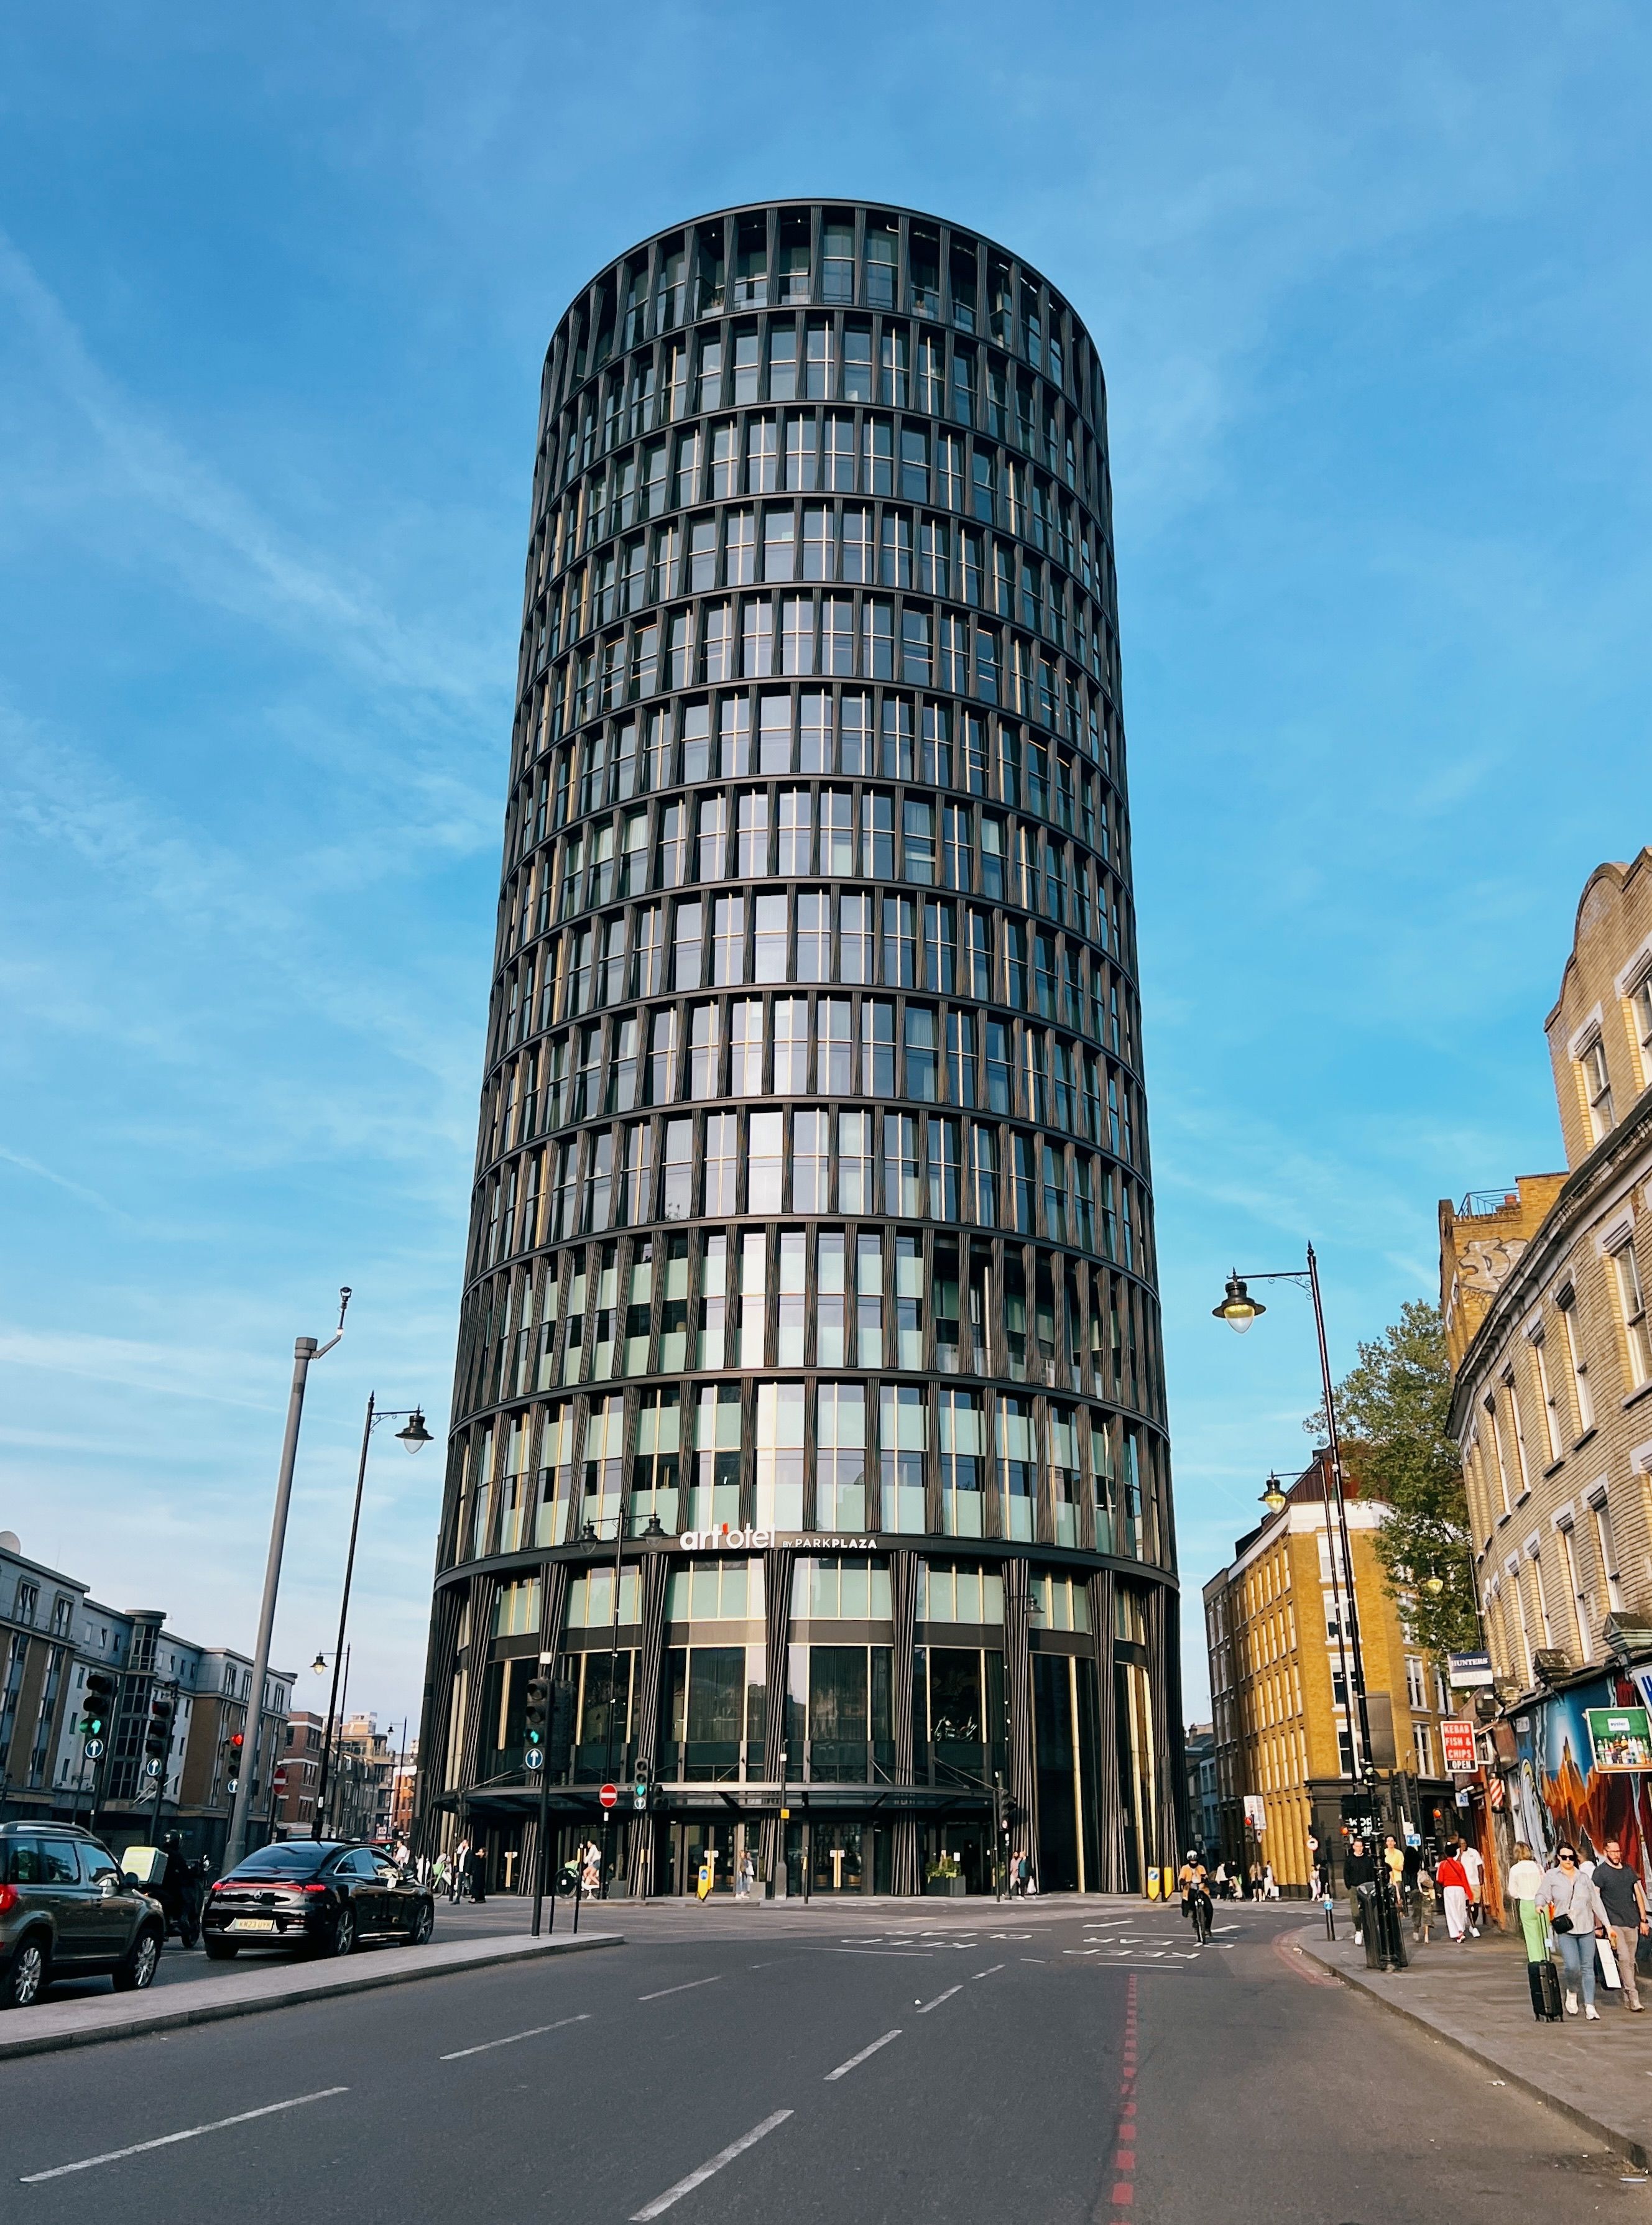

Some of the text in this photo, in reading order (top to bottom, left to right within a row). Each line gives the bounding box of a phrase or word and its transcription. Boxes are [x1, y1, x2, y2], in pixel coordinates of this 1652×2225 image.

[680, 1522, 775, 1550] art'otel
[1451, 1657, 1488, 1667] HUNTERS
[1444, 1725, 1470, 1734] KEBAB
[1445, 1737, 1472, 1746] FISH &
[1447, 1749, 1472, 1759] CHIPS
[1452, 1760, 1472, 1769] OPEN
[841, 1938, 979, 1949] KEEP
[1082, 1938, 1235, 1949] CLEAR
[1063, 1949, 1201, 1960] KEEP
